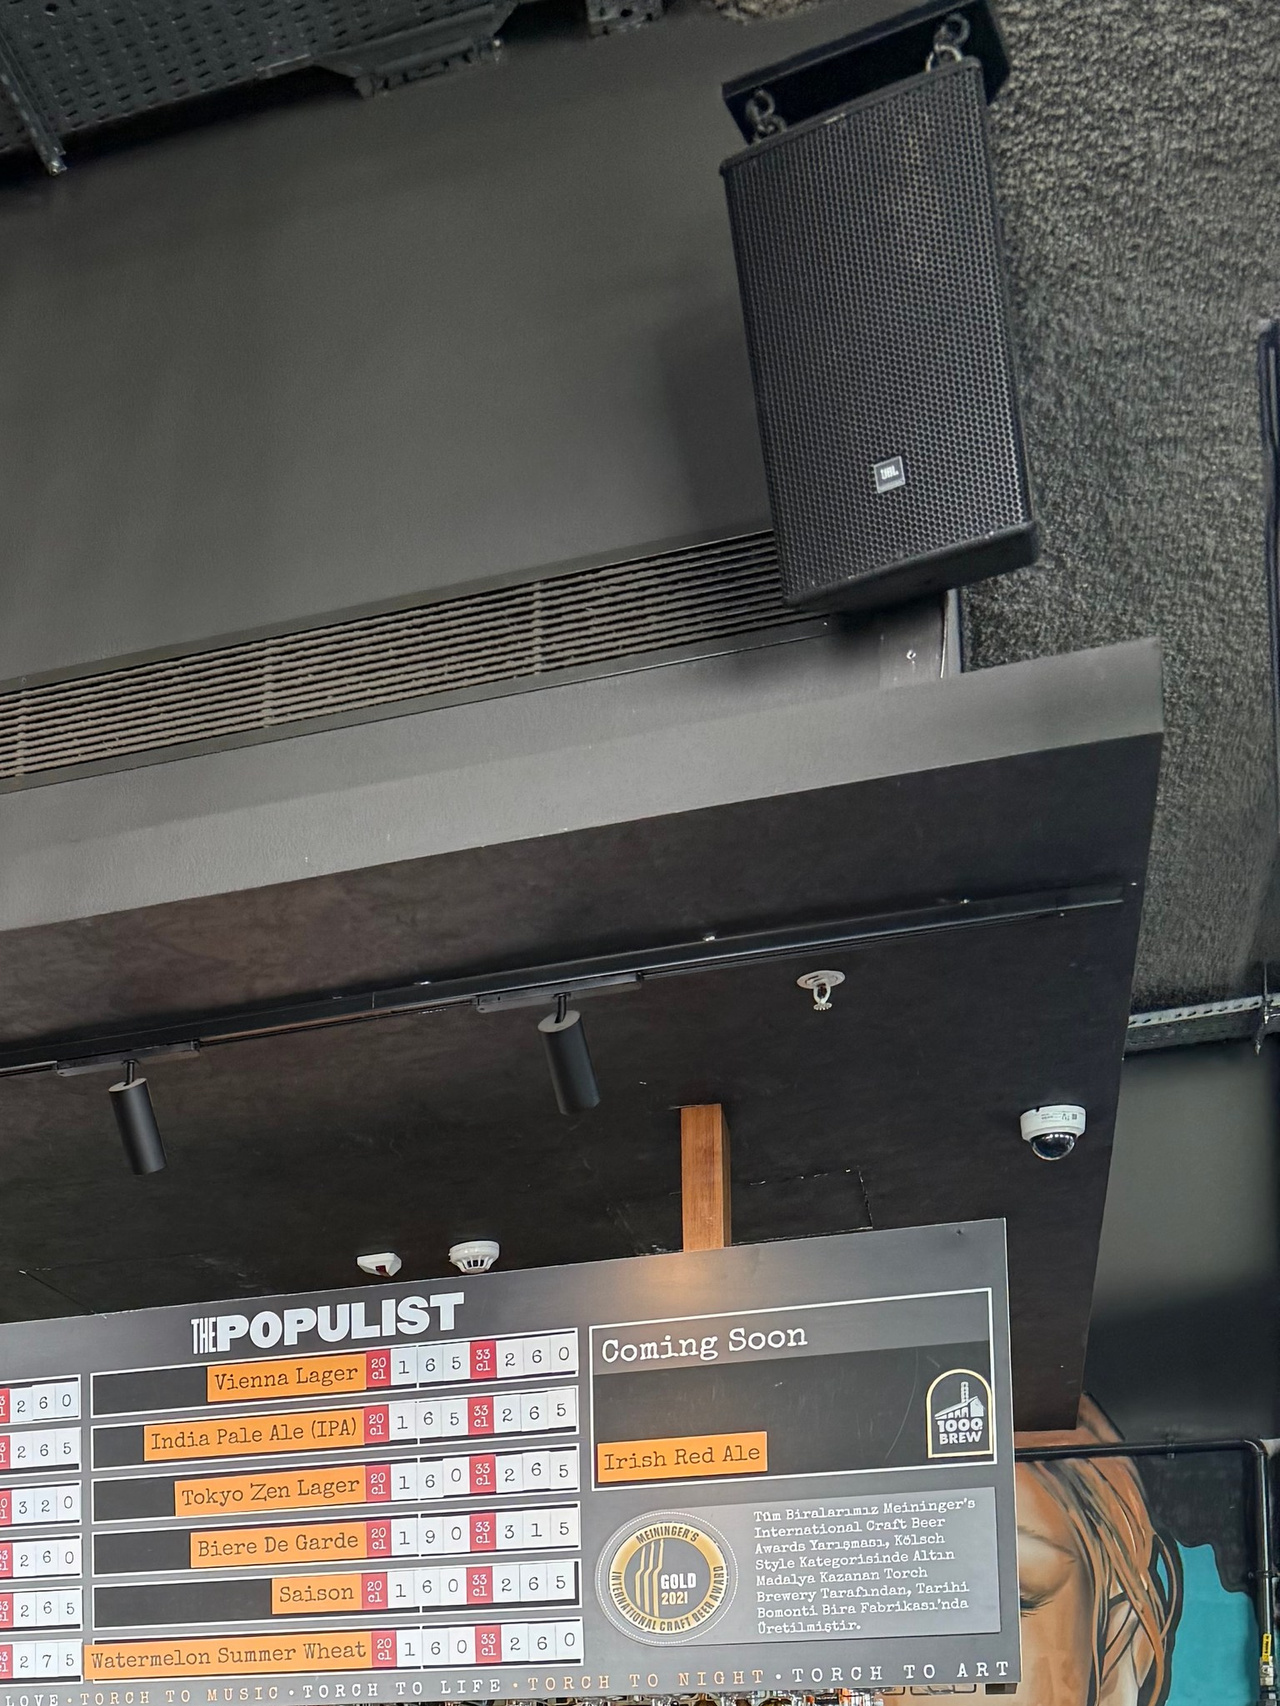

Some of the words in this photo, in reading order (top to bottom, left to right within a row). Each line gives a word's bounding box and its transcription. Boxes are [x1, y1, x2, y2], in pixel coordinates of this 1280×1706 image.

[217, 1292, 464, 1351] POPULIST
[602, 1334, 718, 1363] Coming
[729, 1325, 808, 1353] Soon
[476, 1349, 490, 1360] 33
[371, 1358, 386, 1369] 20
[215, 1372, 290, 1390] Vienna
[296, 1364, 358, 1387] Lager
[369, 1413, 384, 1425] 20
[474, 1405, 488, 1416] 33
[151, 1431, 210, 1450] India
[217, 1427, 263, 1445] Pale
[269, 1423, 304, 1441] Ale
[310, 1417, 357, 1441] (IPA)
[940, 1430, 982, 1445] BREW
[604, 1450, 667, 1470] Irish
[674, 1447, 715, 1464] Red
[722, 1444, 760, 1463] Ale
[475, 1463, 490, 1474] 33
[370, 1473, 386, 1484] 20
[182, 1483, 244, 1507] Tokyo
[250, 1483, 290, 1502] Zen
[297, 1477, 360, 1500] Lager
[884, 1498, 976, 1514] Meininger's
[371, 1528, 386, 1539] 20
[475, 1520, 490, 1531] 33
[754, 1522, 862, 1539] International
[866, 1519, 907, 1531] Craft
[912, 1518, 946, 1529] Beer
[636, 1525, 699, 1544] MEININGER'S
[198, 1538, 258, 1558] Biere
[265, 1535, 288, 1553] De
[295, 1533, 358, 1551] Garde
[755, 1542, 806, 1554] Awards
[894, 1533, 945, 1546] Kölsch
[756, 1560, 795, 1571] Style
[800, 1553, 908, 1568] Kategorisinde
[913, 1550, 955, 1561] Altın
[472, 1573, 487, 1584] 33
[660, 1573, 696, 1589] GOLD
[757, 1574, 816, 1586] Madalya
[820, 1570, 880, 1583] Kazanan
[884, 1567, 928, 1579] Torch
[279, 1583, 354, 1602] Saison
[367, 1580, 382, 1591] 20
[757, 1591, 816, 1603] Brewery
[916, 1582, 970, 1593] Tarihi
[611, 1571, 657, 1630] INTERNATIONAL
[659, 1617, 691, 1631] CRAFT
[694, 1601, 715, 1622] BEER
[710, 1566, 724, 1601] AWARD
[662, 1591, 688, 1605] 2021
[758, 1606, 818, 1619] Bomonti
[822, 1604, 856, 1615] Bira
[377, 1638, 392, 1649] 20
[481, 1633, 495, 1645] 33
[91, 1646, 211, 1668] Watermelon
[217, 1645, 297, 1665] Summer
[304, 1639, 367, 1658] Wheat
[81, 1690, 152, 1706] TORCH
[166, 1689, 191, 1703] TO
[207, 1686, 279, 1702] MUSIC
[303, 1681, 380, 1698] TORCH
[397, 1680, 424, 1696] TO
[441, 1678, 502, 1695] LIFE
[528, 1673, 610, 1694] TORCH
[630, 1673, 662, 1689] TO
[679, 1669, 765, 1686] NIGHT
[792, 1665, 884, 1682] TORCH
[904, 1664, 936, 1679] TO
[957, 1661, 1010, 1678] ART
